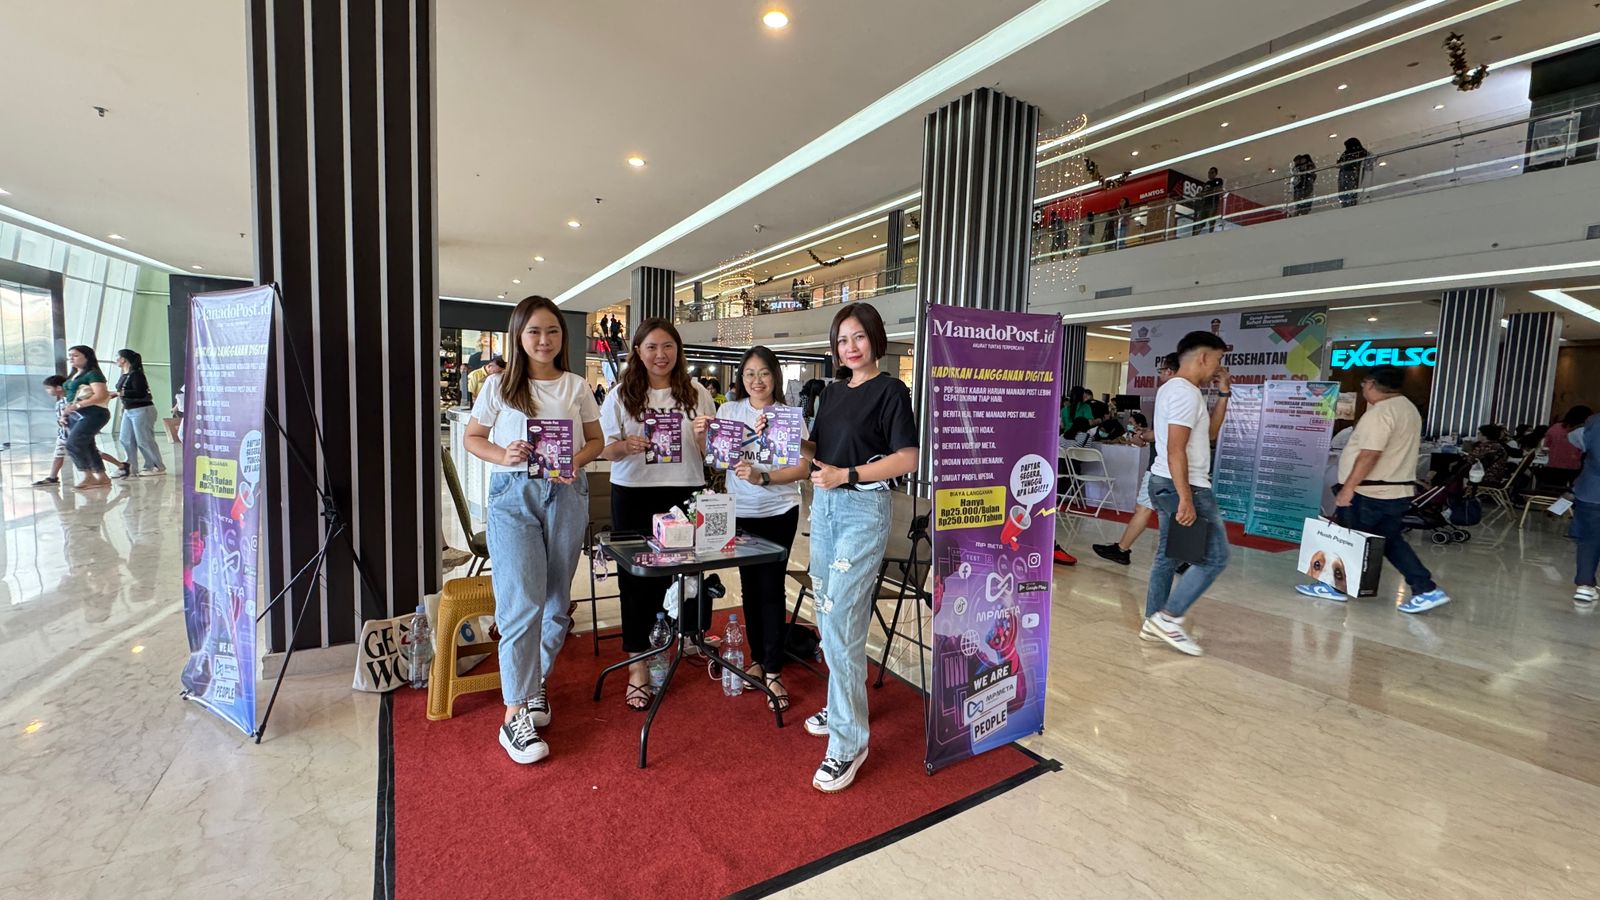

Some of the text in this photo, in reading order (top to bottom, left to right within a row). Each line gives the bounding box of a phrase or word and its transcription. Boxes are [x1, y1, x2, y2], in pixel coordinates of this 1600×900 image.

[1140, 188, 1164, 199] MANTOS
[932, 319, 1054, 344] ManadoPost.id
[1225, 352, 1288, 366] KESEHATAN
[932, 366, 1054, 382] HADIRKAN LANGGANAN DIGITAL
[1134, 376, 1155, 388] HARI
[1020, 462, 1041, 472] DAFTAR
[1021, 478, 1042, 488] TUNGGU
[1016, 489, 1027, 497] APA
[960, 499, 984, 508] Hanya
[941, 506, 1000, 517] Rp25.000/Bulan
[938, 514, 1003, 526] Rp250.000/Tahun
[1317, 530, 1353, 547] Hush Puppies
[976, 606, 1021, 622] MPMETA
[974, 666, 1009, 690] WE ARE
[974, 710, 1006, 738] PEOPLE
